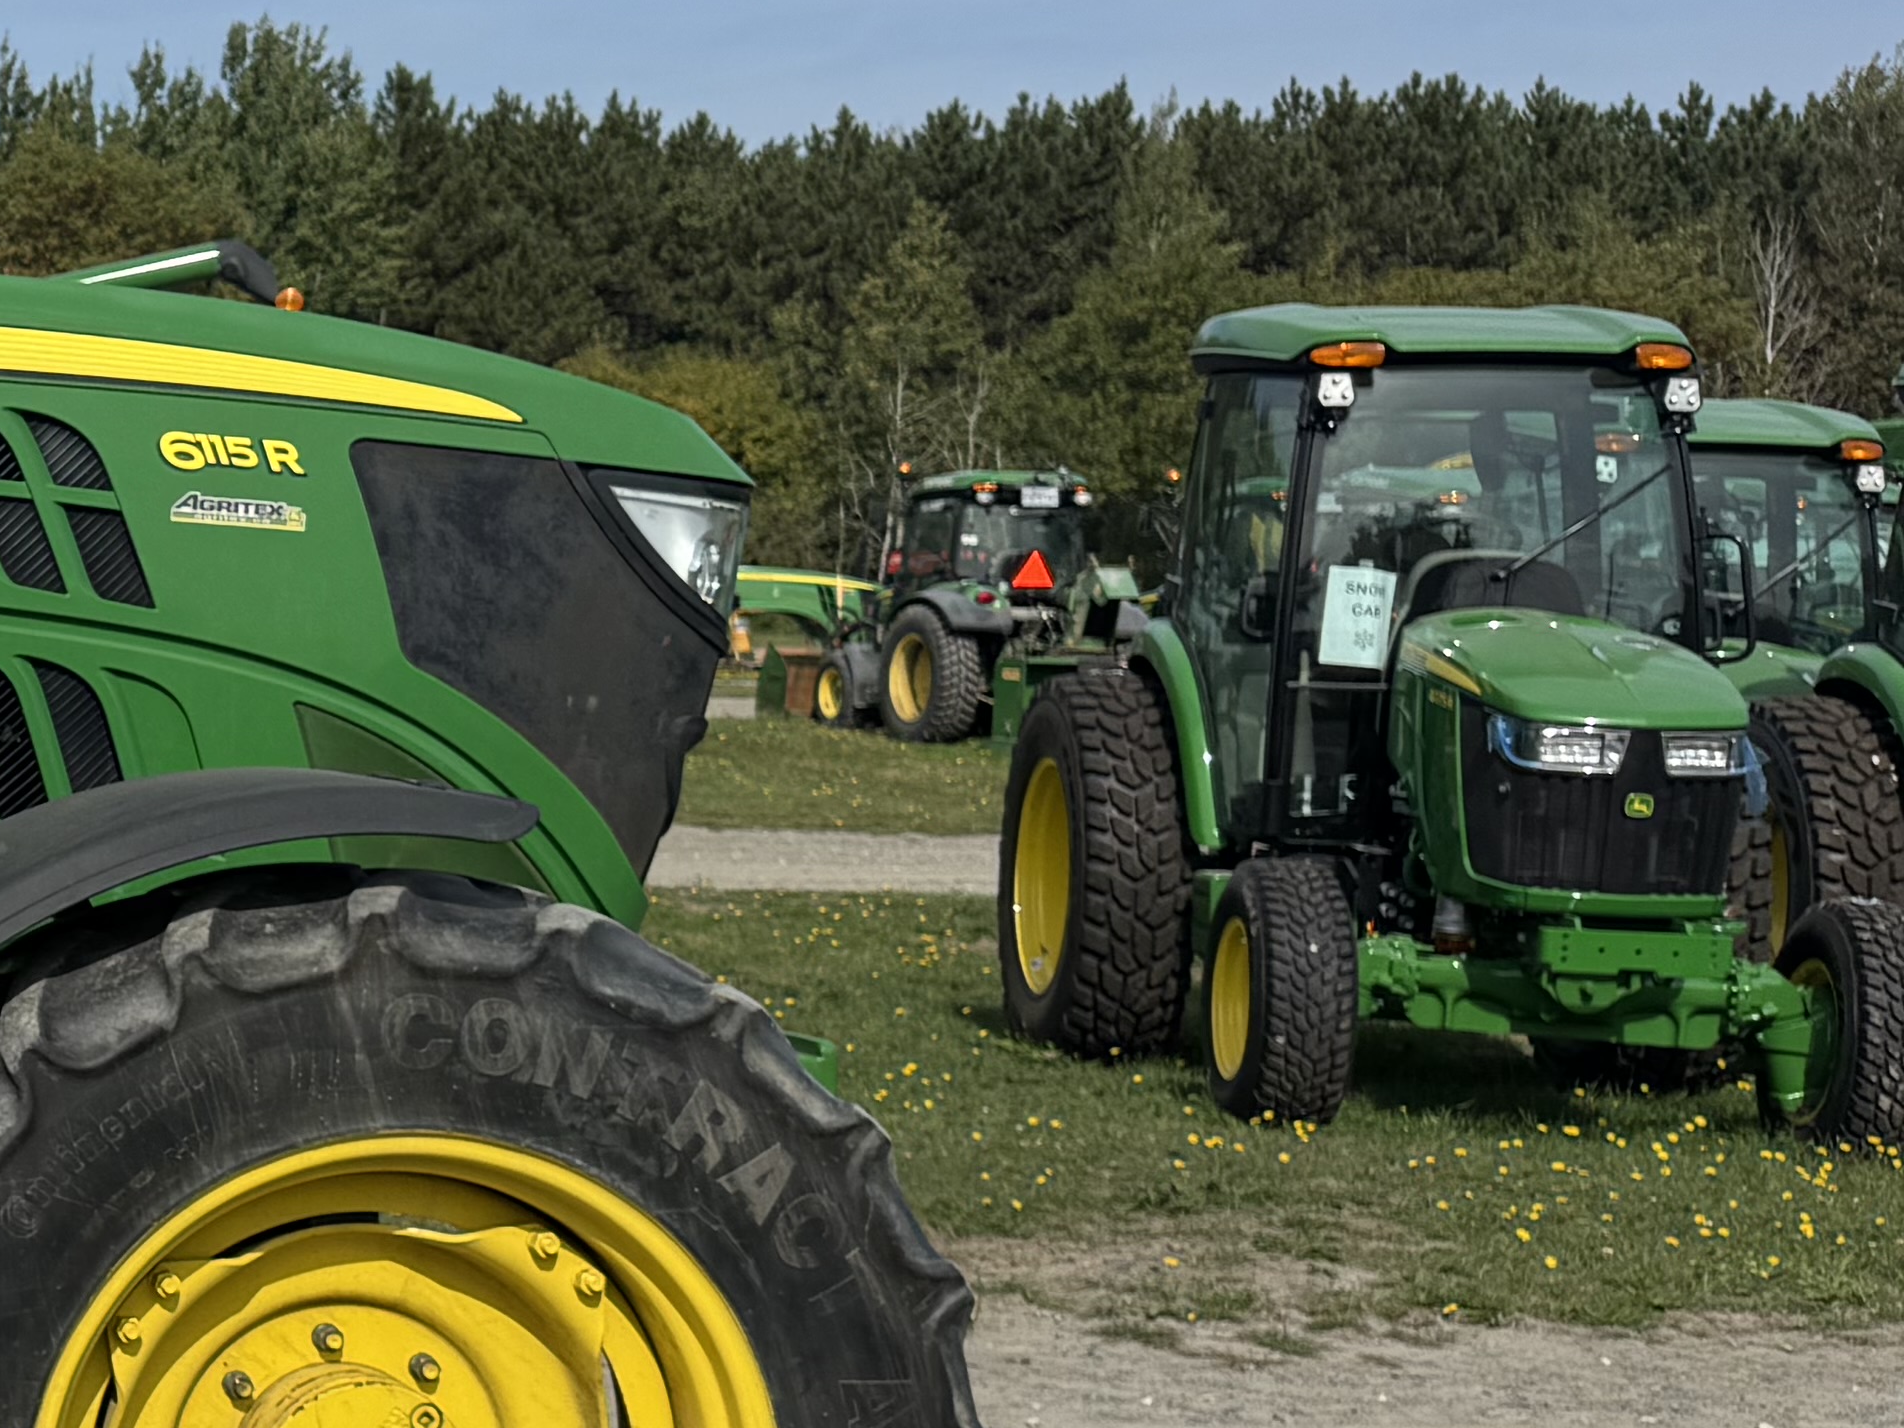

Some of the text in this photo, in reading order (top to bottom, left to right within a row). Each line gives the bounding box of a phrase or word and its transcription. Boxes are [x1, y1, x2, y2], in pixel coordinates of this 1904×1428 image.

[159, 431, 306, 475] 6115 R
[175, 494, 285, 516] AGRITEX
